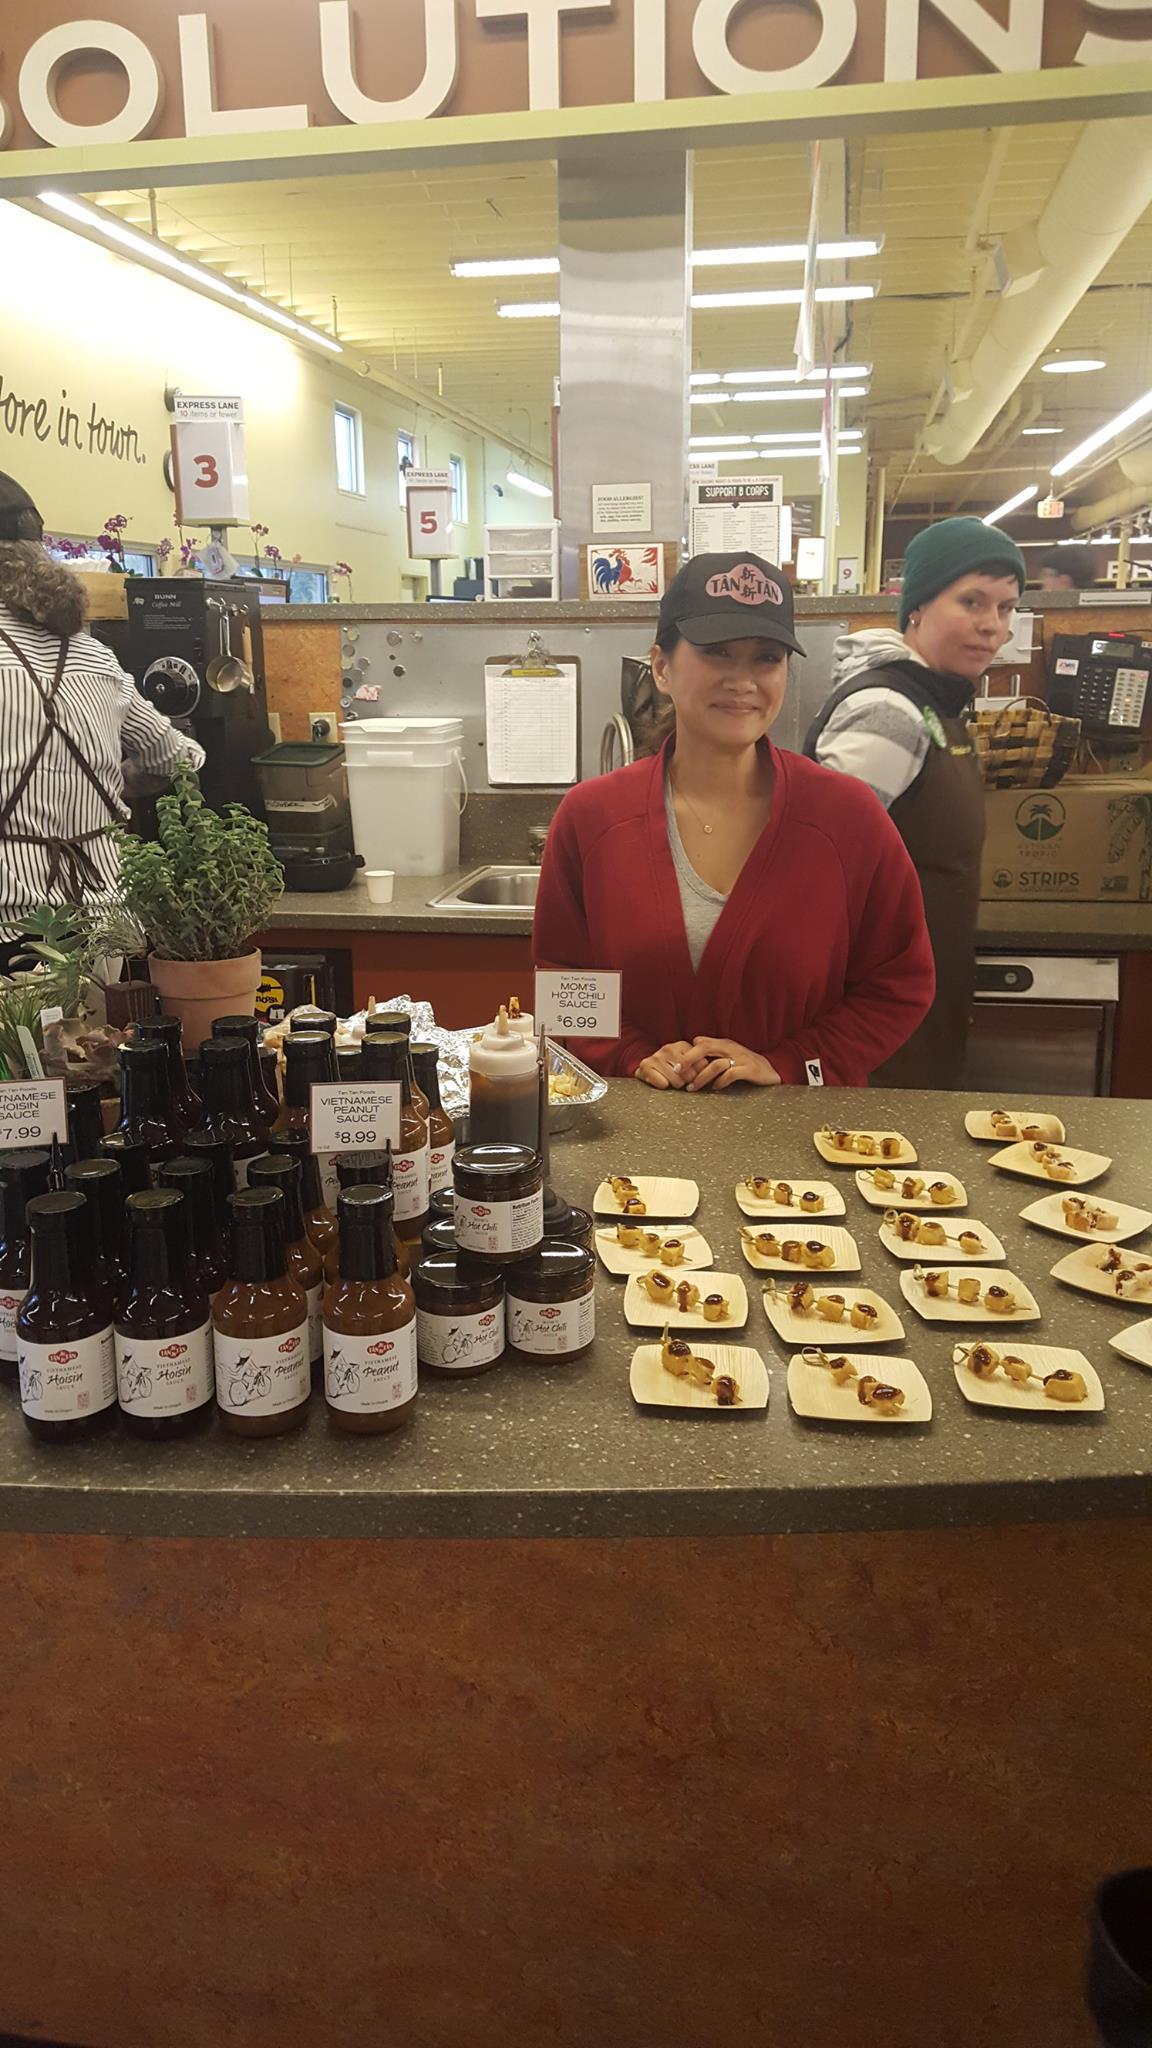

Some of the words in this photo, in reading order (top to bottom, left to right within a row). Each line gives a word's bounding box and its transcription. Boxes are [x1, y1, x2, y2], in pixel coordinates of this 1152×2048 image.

[0, 0, 1152, 148] OLUTION
[176, 401, 216, 409] EXPRESS
[0, 375, 50, 442] ore
[58, 389, 83, 450] in
[87, 402, 146, 464] town.
[190, 410, 208, 418] items
[193, 454, 219, 488] 3
[705, 486, 736, 497] SUPPORT
[739, 486, 744, 496] B
[745, 485, 769, 496] CORPS
[420, 511, 438, 534] 5
[843, 568, 852, 579] 9
[151, 600, 168, 609] Coffee
[1019, 871, 1080, 887] STRIPS
[560, 982, 597, 991] MOM'S
[551, 991, 575, 999] HOT
[577, 991, 606, 1000] CHILI
[559, 1000, 597, 1008] SAUCE
[556, 1015, 597, 1028] $6.99
[320, 1095, 393, 1106] VIETNAMESE
[333, 1105, 379, 1114] PEANUT
[336, 1114, 376, 1123] SAUCE
[334, 1130, 377, 1144] $8.99
[466, 1221, 481, 1231] Hot
[156, 1365, 192, 1381] Hoisin
[362, 1360, 399, 1378] Peanut
[46, 1371, 83, 1386] Hoisin
